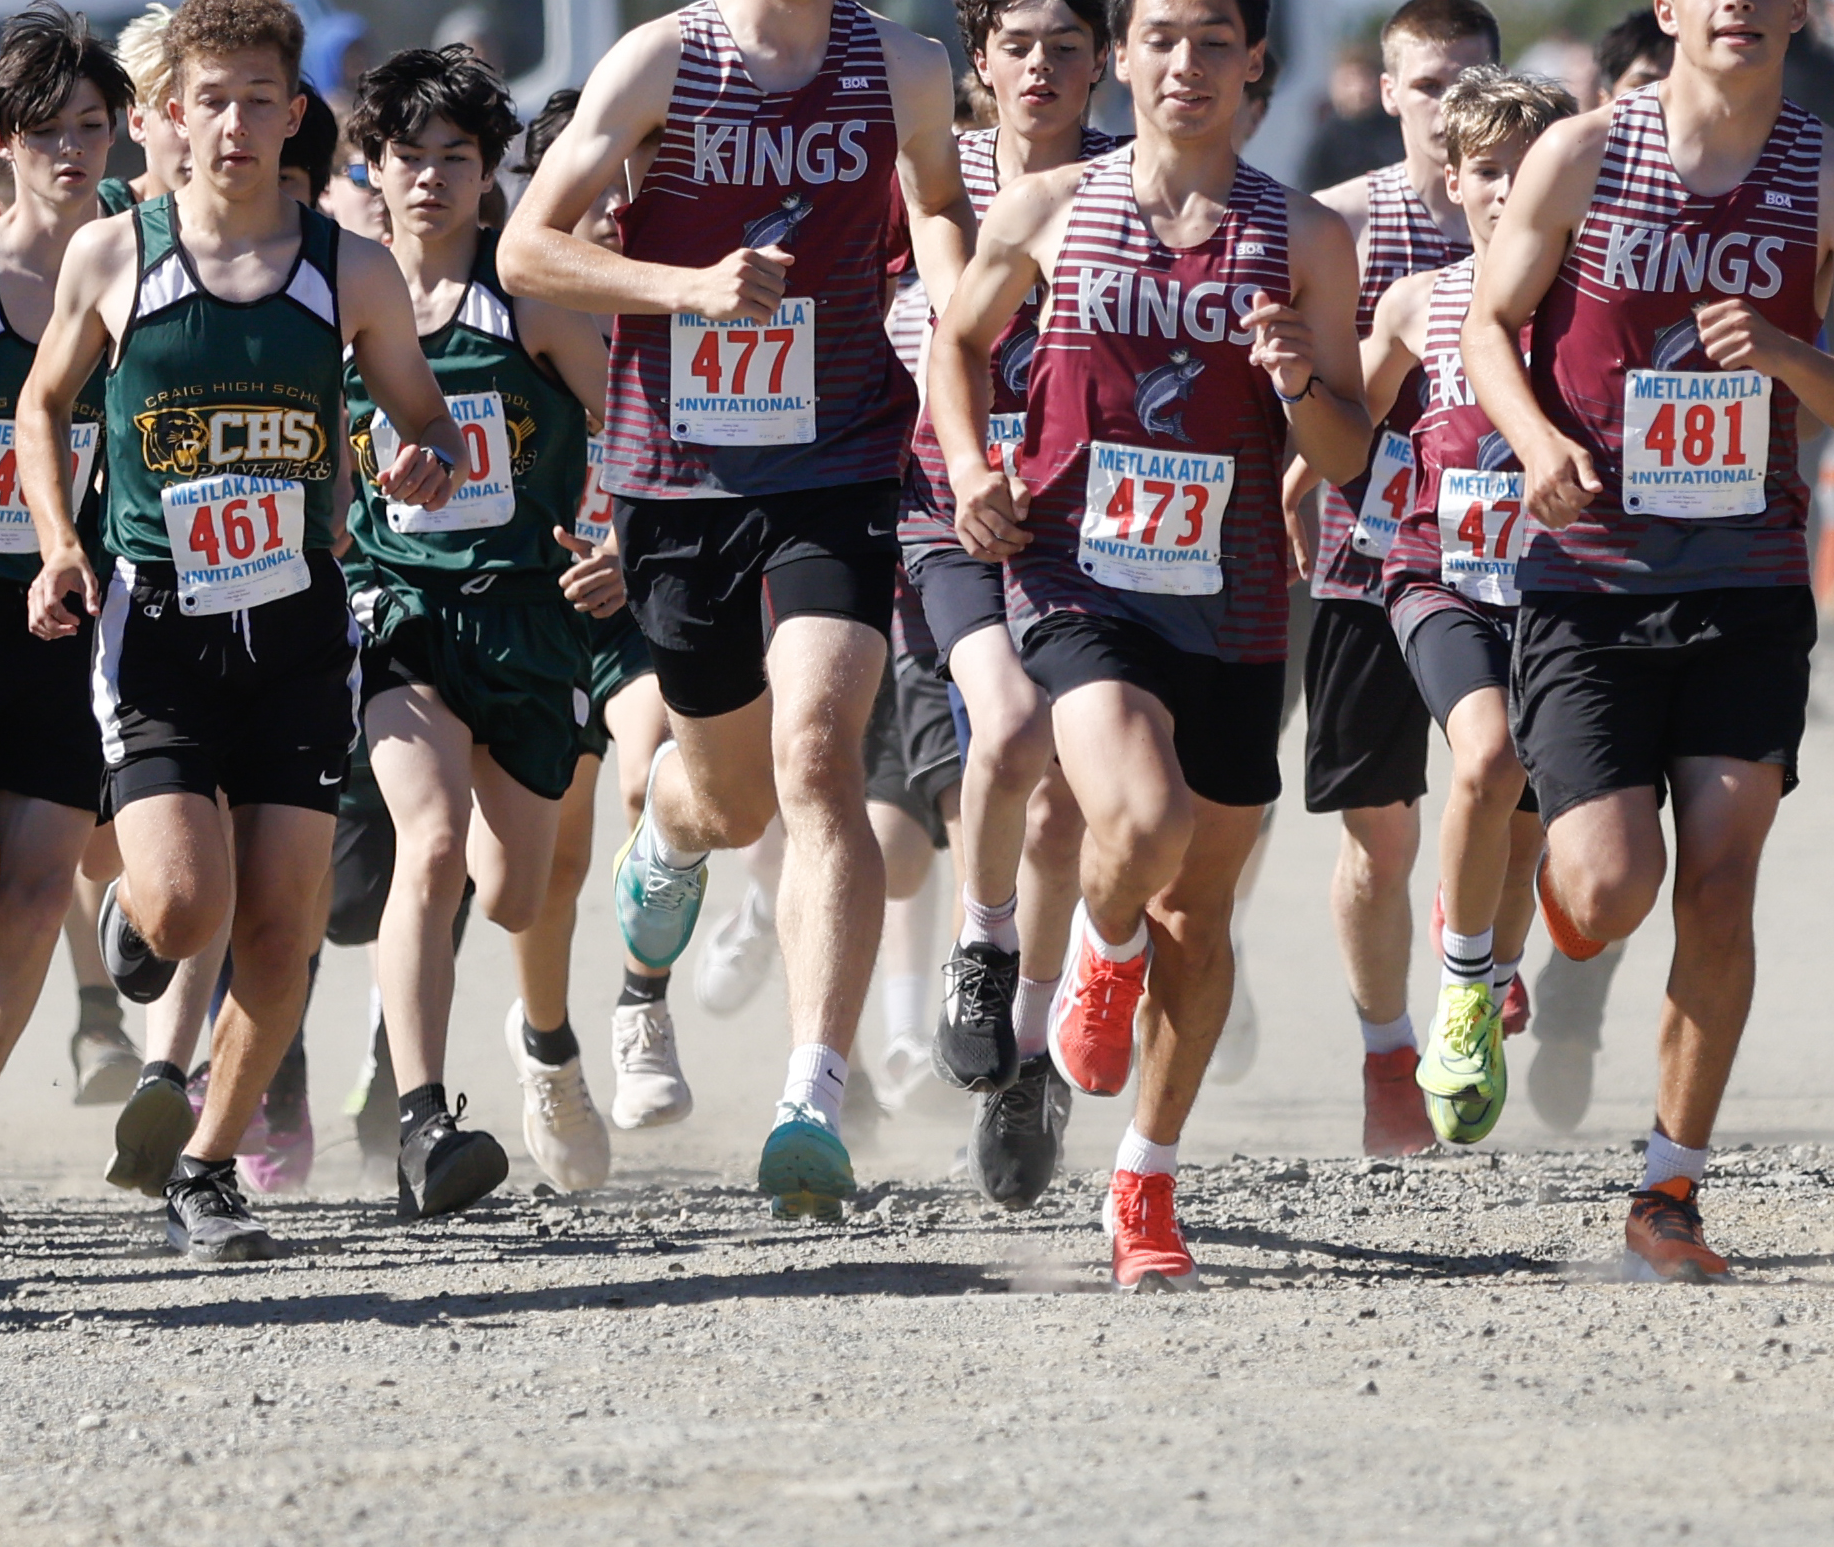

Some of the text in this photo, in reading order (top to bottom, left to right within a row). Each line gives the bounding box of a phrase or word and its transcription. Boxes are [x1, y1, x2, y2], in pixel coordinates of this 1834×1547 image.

[841, 77, 869, 90] BOA
[693, 119, 869, 186] KINGS
[1765, 192, 1792, 208] BOA
[1235, 243, 1265, 256] BOA
[1603, 223, 1786, 300] KINGS
[1077, 267, 1264, 346] KINGS
[690, 328, 795, 395] 477
[145, 384, 205, 410] CRAIG
[213, 381, 265, 393] HIGH
[678, 396, 806, 413] INVITATIONAL
[1634, 375, 1762, 401] METLAKATLA
[208, 409, 316, 466] CHS
[1644, 400, 1747, 467] 481
[1096, 448, 1226, 483] METLAKATLA
[1631, 468, 1757, 485] INVITATIONAL
[170, 476, 296, 507] METLAKATLA
[1449, 475, 1523, 499] METLAK
[188, 493, 285, 566] 461
[1105, 476, 1210, 548] 473
[1457, 500, 1522, 560] 47
[180, 548, 296, 585] INVITATIONAL
[1087, 539, 1212, 563] INVITATIONAL
